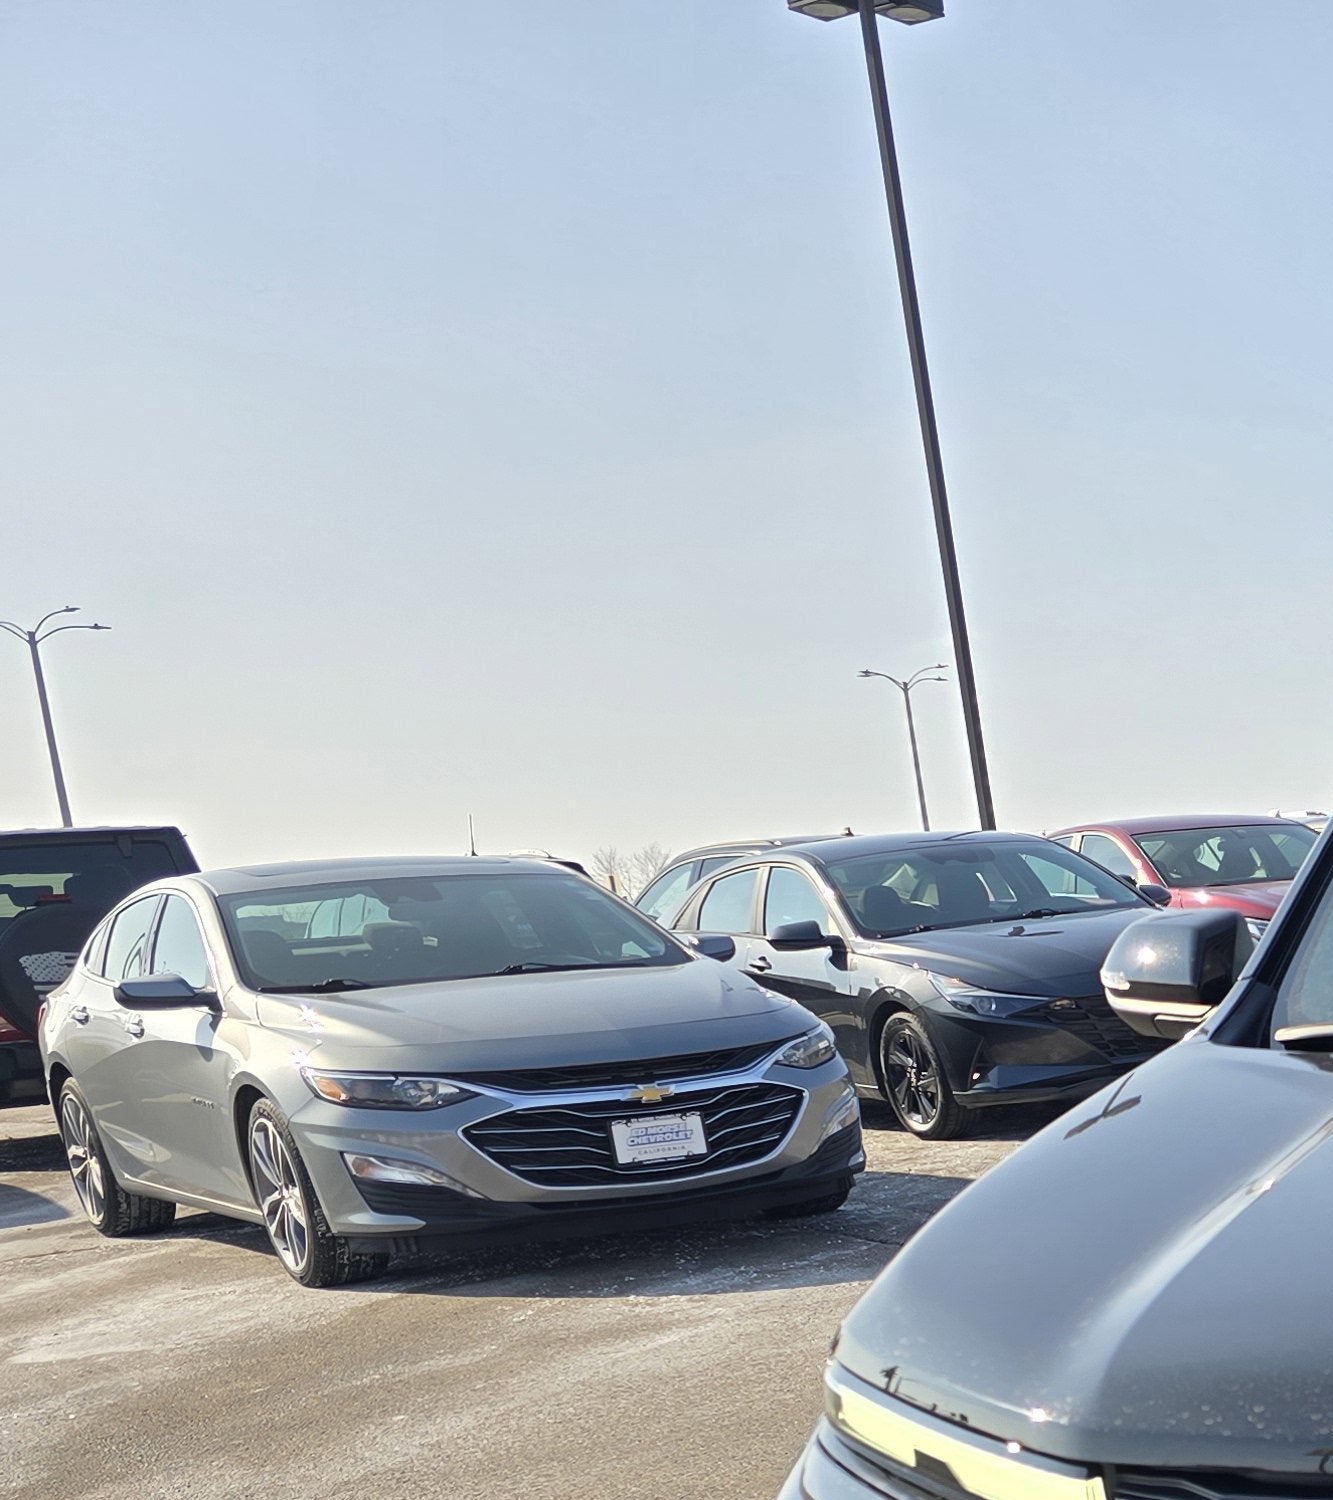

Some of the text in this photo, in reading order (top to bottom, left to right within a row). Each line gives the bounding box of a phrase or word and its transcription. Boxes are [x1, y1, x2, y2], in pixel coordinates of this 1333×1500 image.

[631, 1127, 646, 1137] ED
[627, 1130, 693, 1146] CHEVROLET
[638, 1145, 687, 1155] CALIFORNIA
